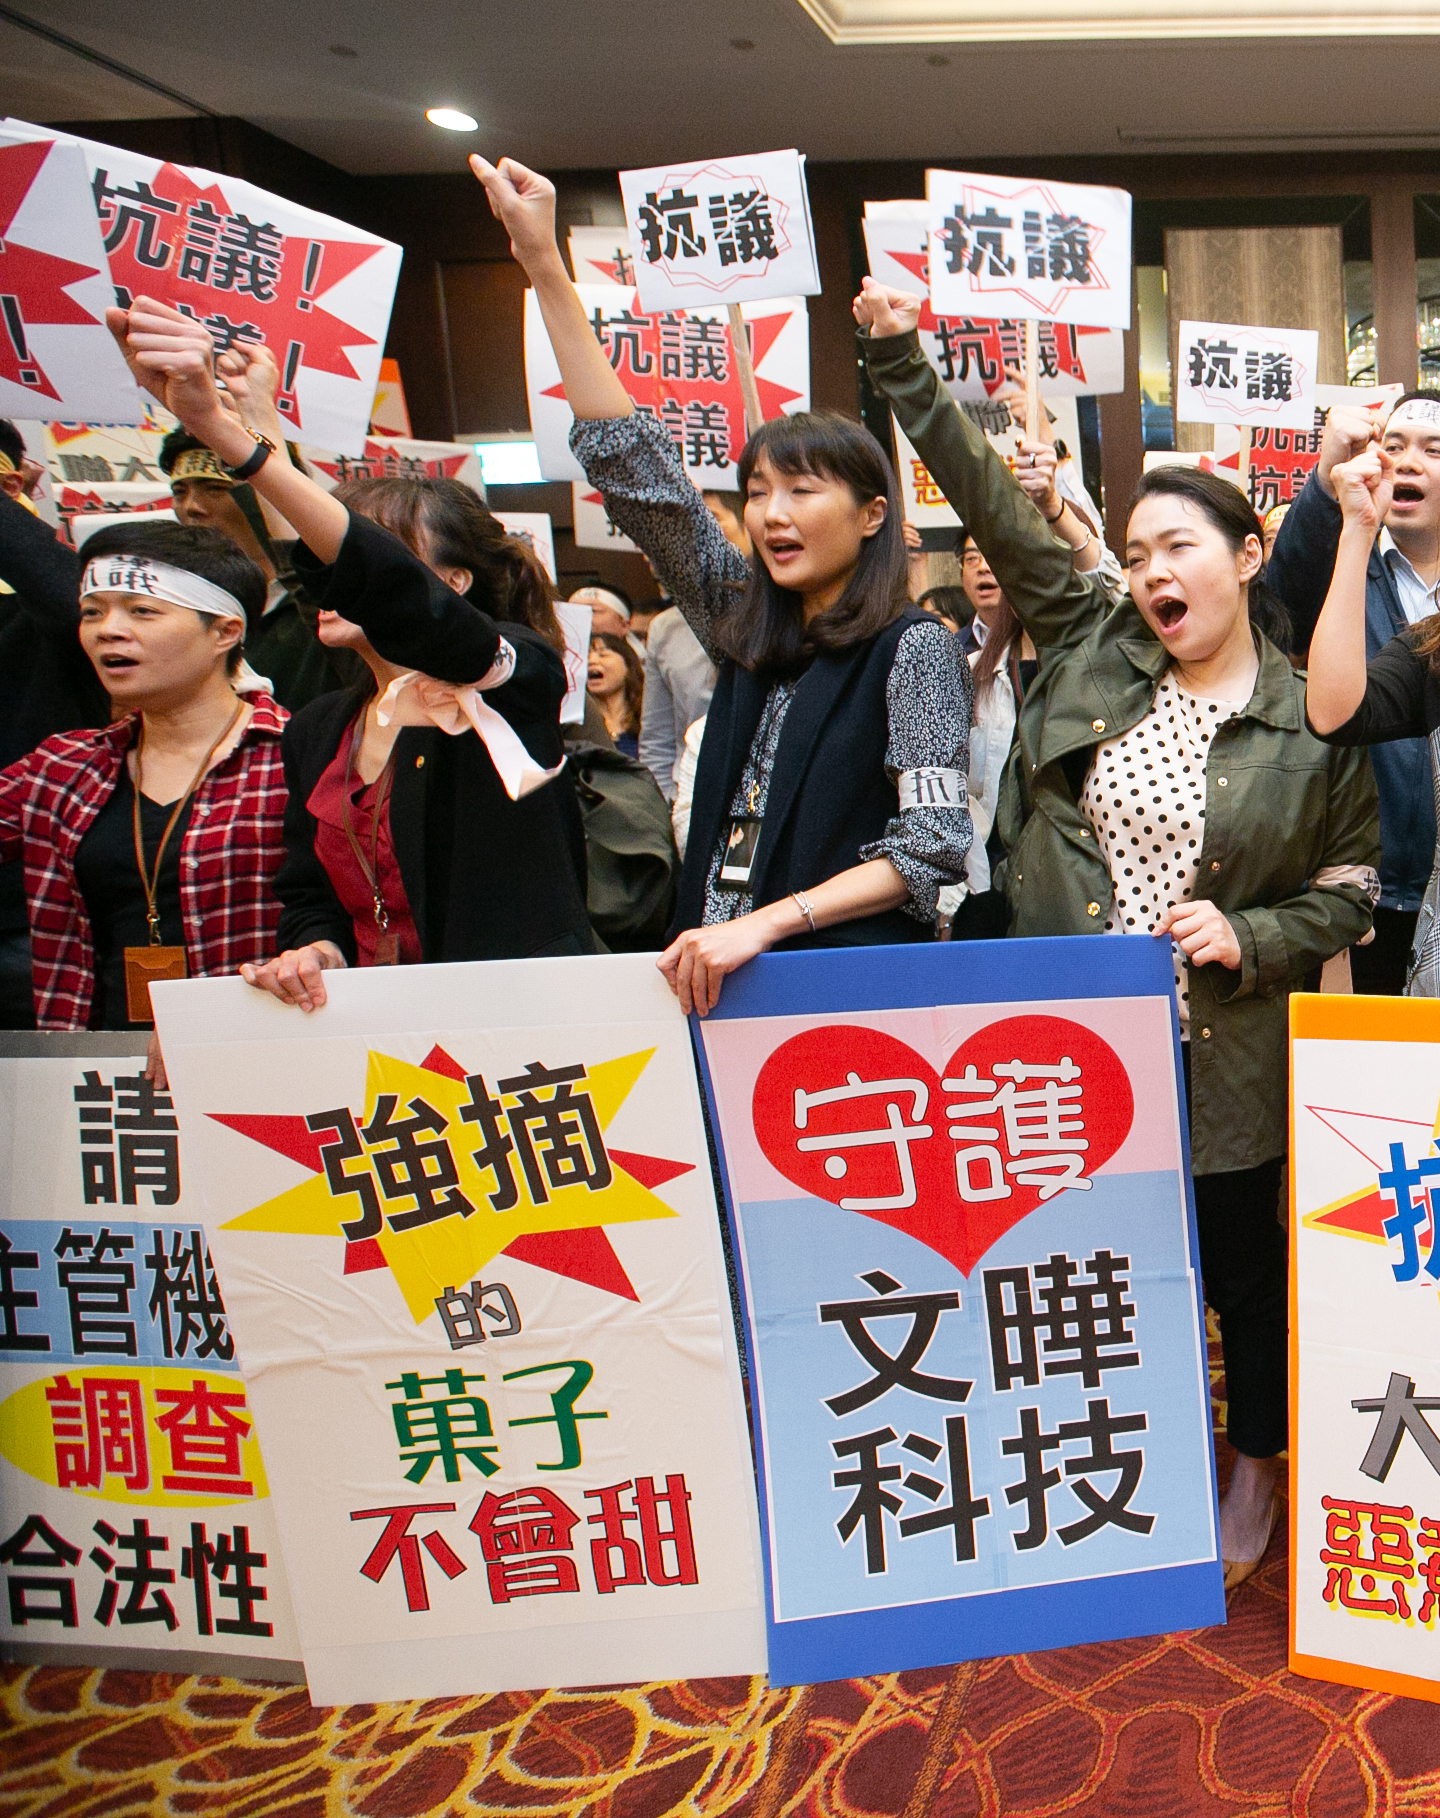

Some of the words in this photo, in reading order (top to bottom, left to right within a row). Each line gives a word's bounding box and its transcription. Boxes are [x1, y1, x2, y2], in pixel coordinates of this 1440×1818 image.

[639, 188, 778, 267] 抗議
[943, 204, 1091, 284] 抗議
[1188, 338, 1293, 402] 抗議
[74, 1069, 181, 1207] 請
[305, 1061, 615, 1244] 強摘
[793, 1056, 1094, 1211] 守護
[434, 1279, 523, 1351] 的
[818, 1248, 1142, 1419] 文曄
[45, 1374, 256, 1497] 調查
[385, 1358, 609, 1484] 菓子
[350, 1473, 699, 1614] 不會甜
[830, 1397, 1157, 1578] 科技
[0, 1514, 274, 1639] 合法性
